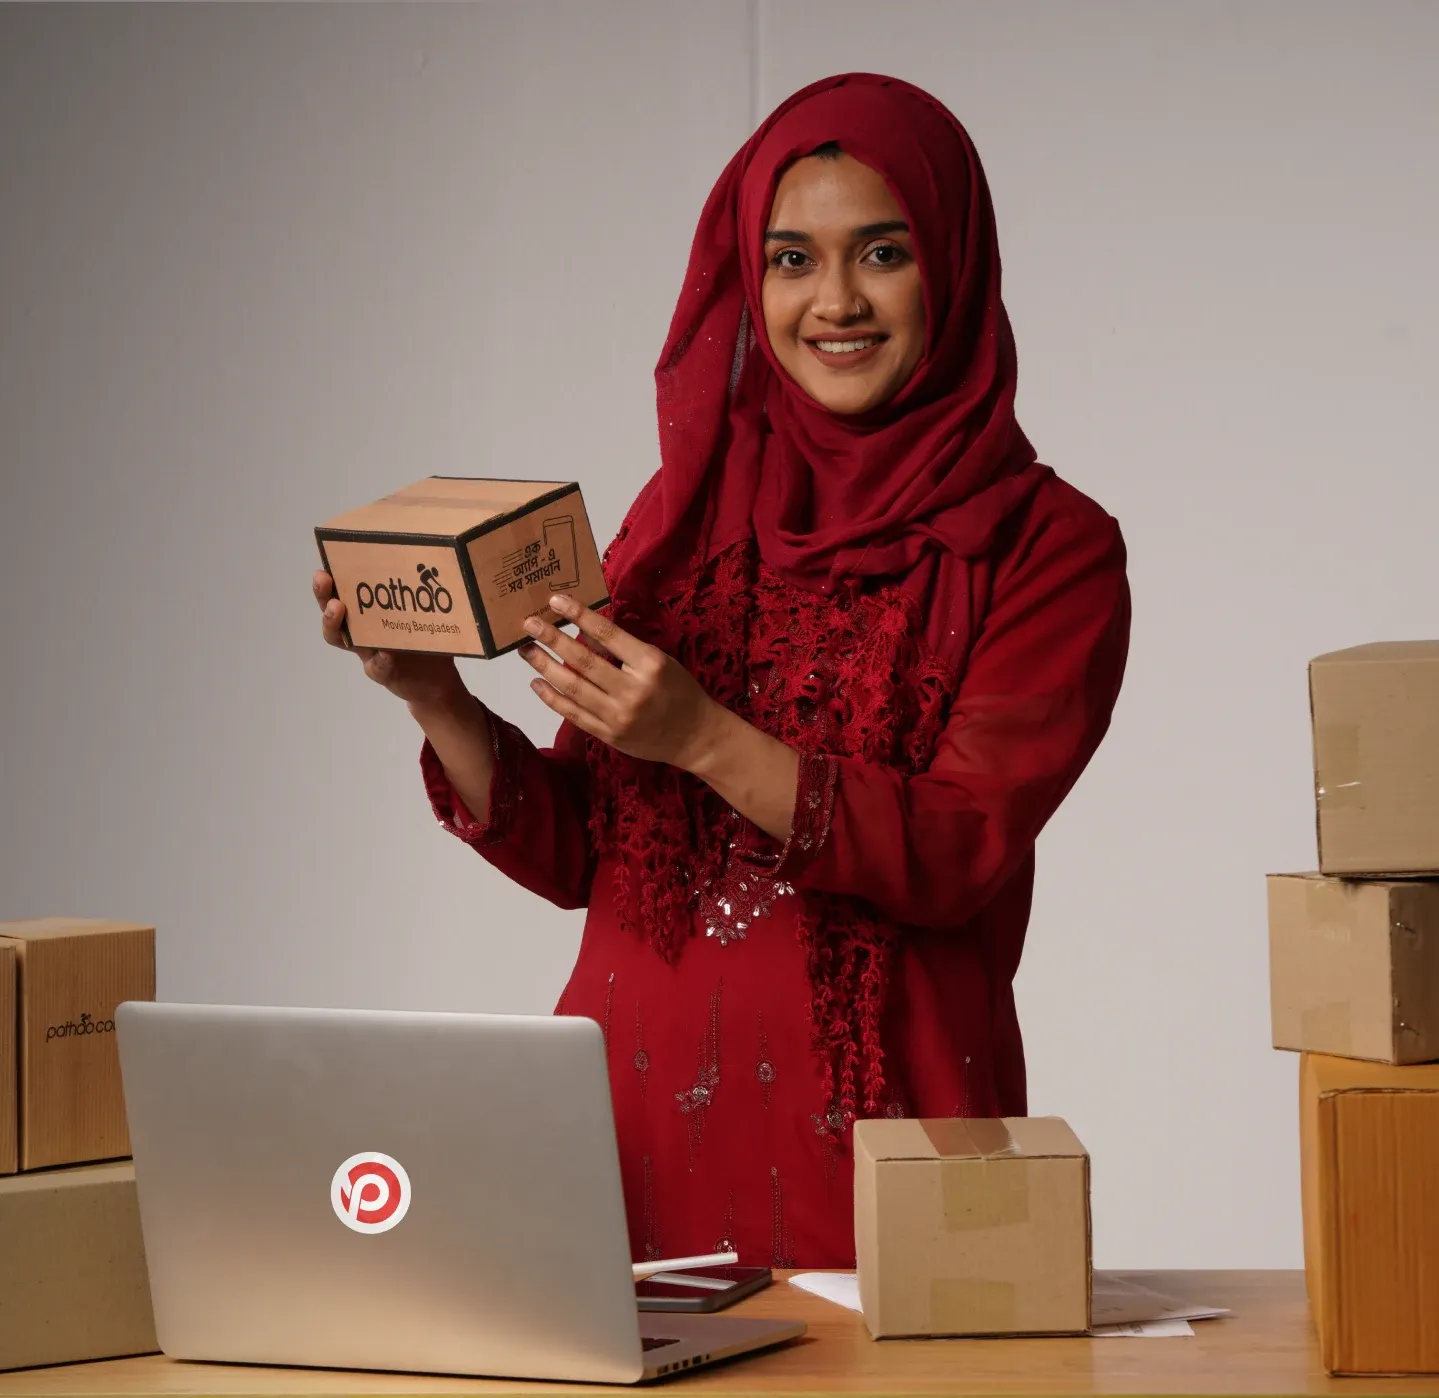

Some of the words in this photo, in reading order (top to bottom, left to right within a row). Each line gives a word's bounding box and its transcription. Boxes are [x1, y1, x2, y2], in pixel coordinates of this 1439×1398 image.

[525, 540, 541, 558] এক
[508, 576, 523, 593] সব
[525, 559, 561, 585] সমাধান
[356, 577, 453, 615] pathao
[381, 618, 412, 634] Moving
[412, 620, 461, 635] Bangladesh
[45, 1020, 95, 1043] pathao
